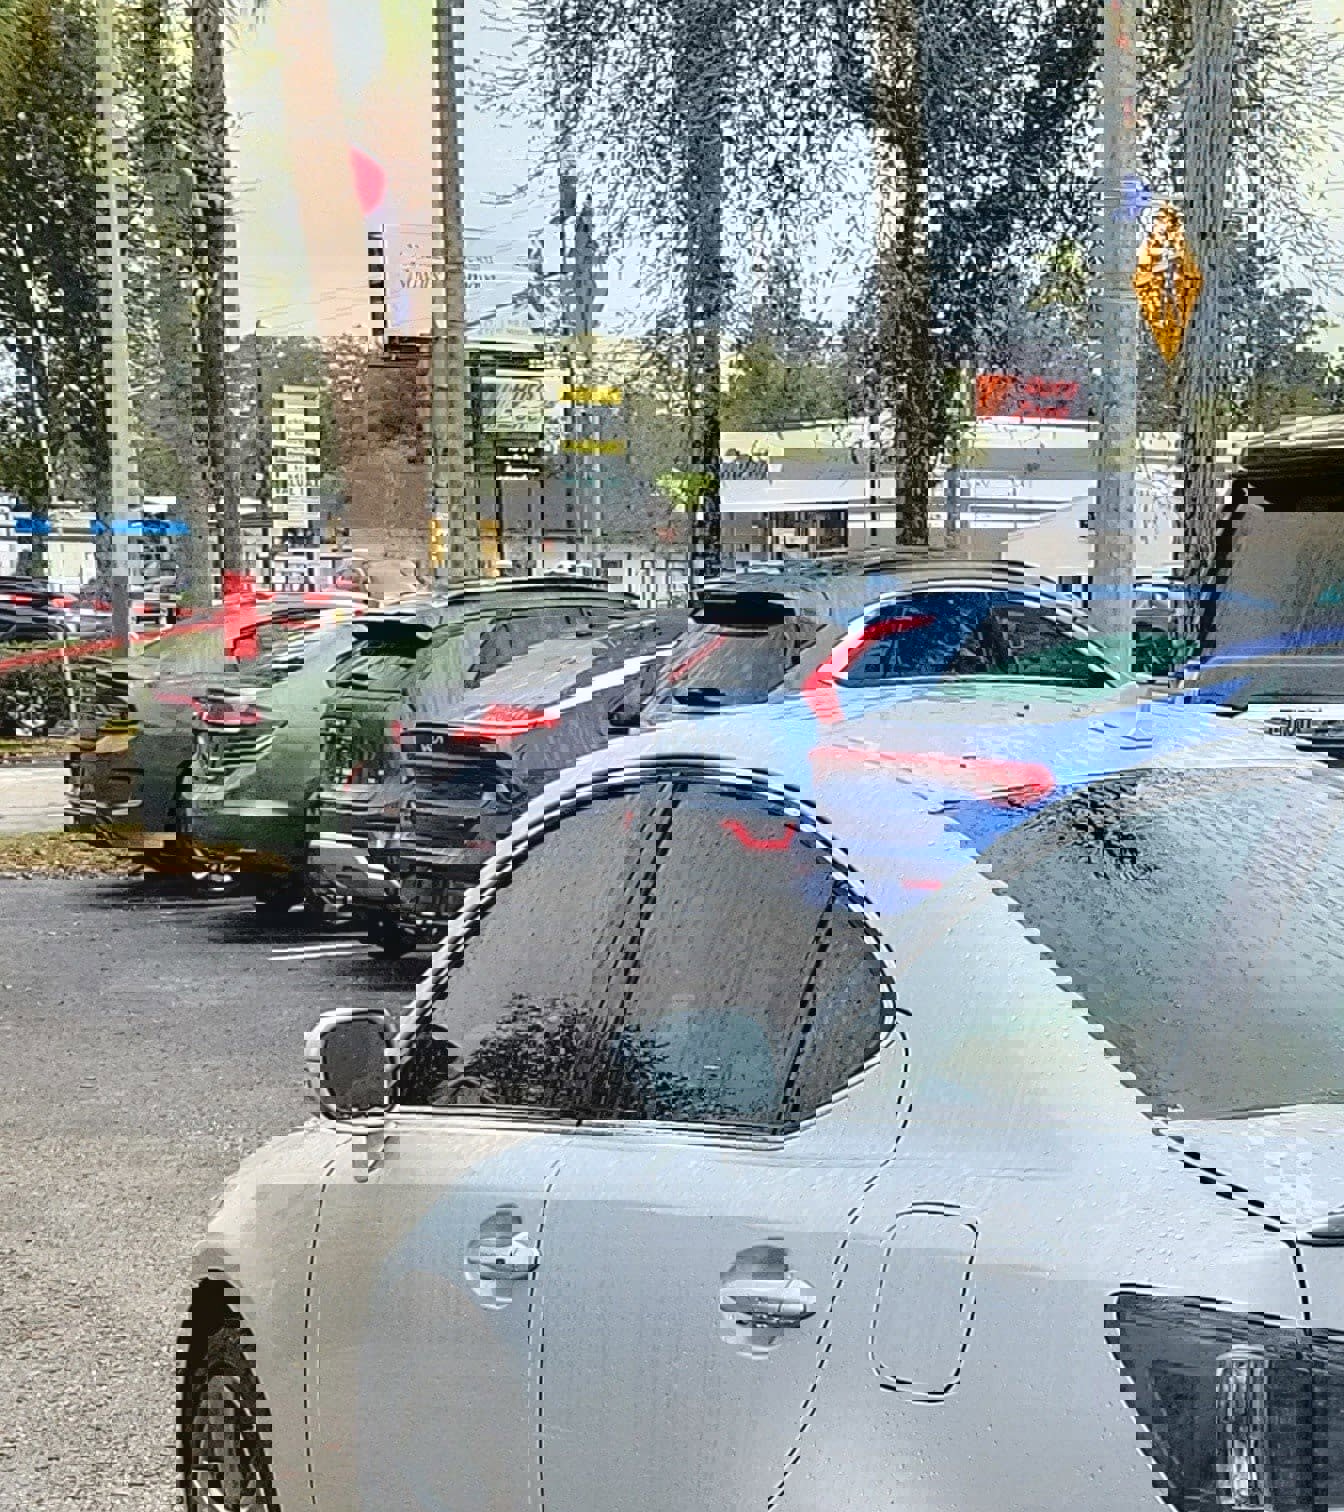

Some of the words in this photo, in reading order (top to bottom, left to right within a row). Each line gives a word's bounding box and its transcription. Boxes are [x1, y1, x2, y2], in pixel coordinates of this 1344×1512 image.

[1022, 376, 1079, 400] Auto
[1009, 400, 1070, 422] Zone
[563, 475, 599, 488] VALUE
